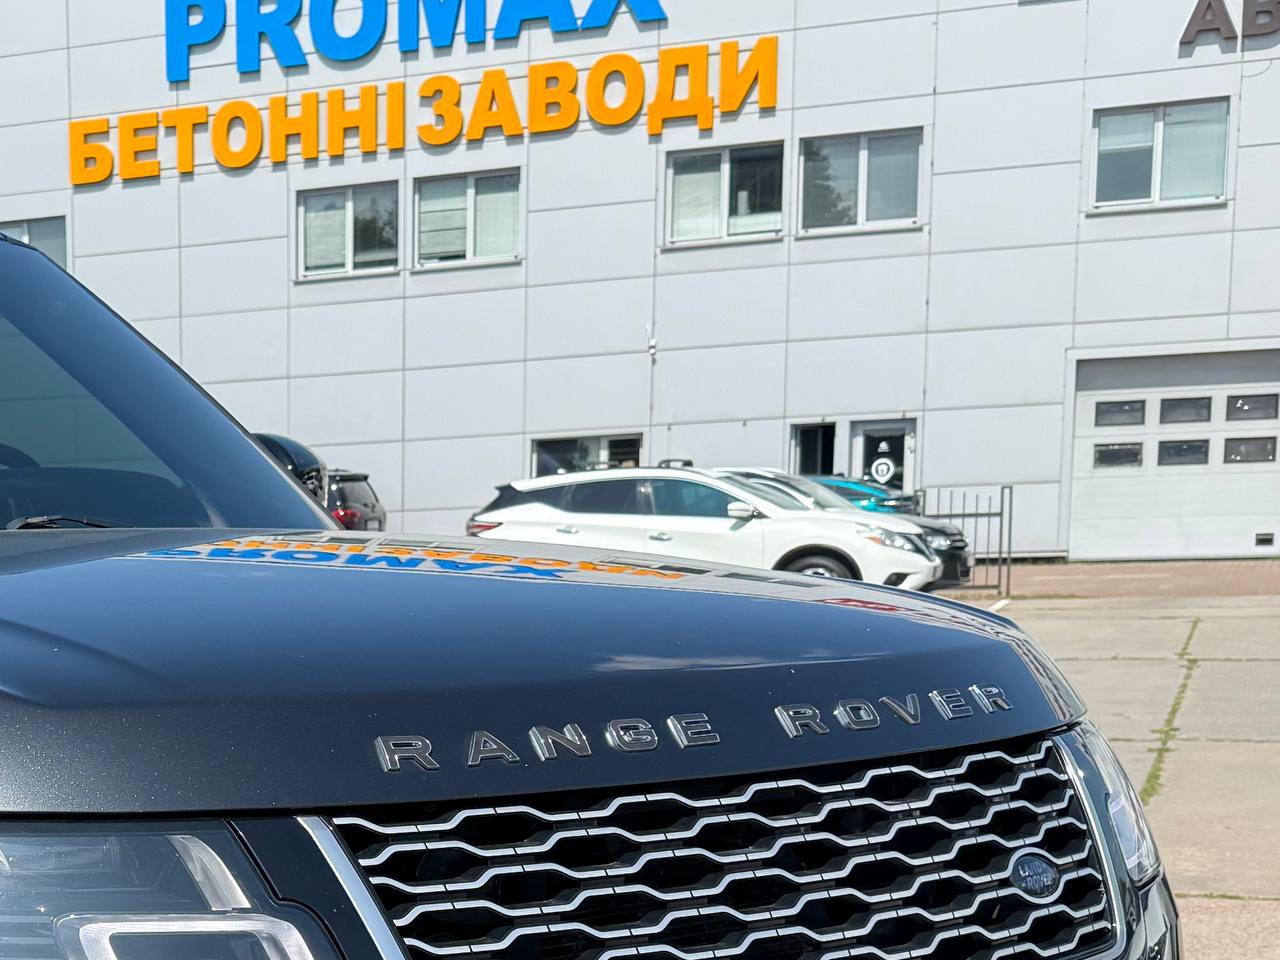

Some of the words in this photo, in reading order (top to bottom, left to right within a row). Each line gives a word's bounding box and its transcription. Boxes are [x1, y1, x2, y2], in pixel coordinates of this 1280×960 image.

[417, 35, 778, 146] ЗАВОДИ
[375, 711, 720, 773] RANGE
[773, 682, 1013, 739] ROVER
